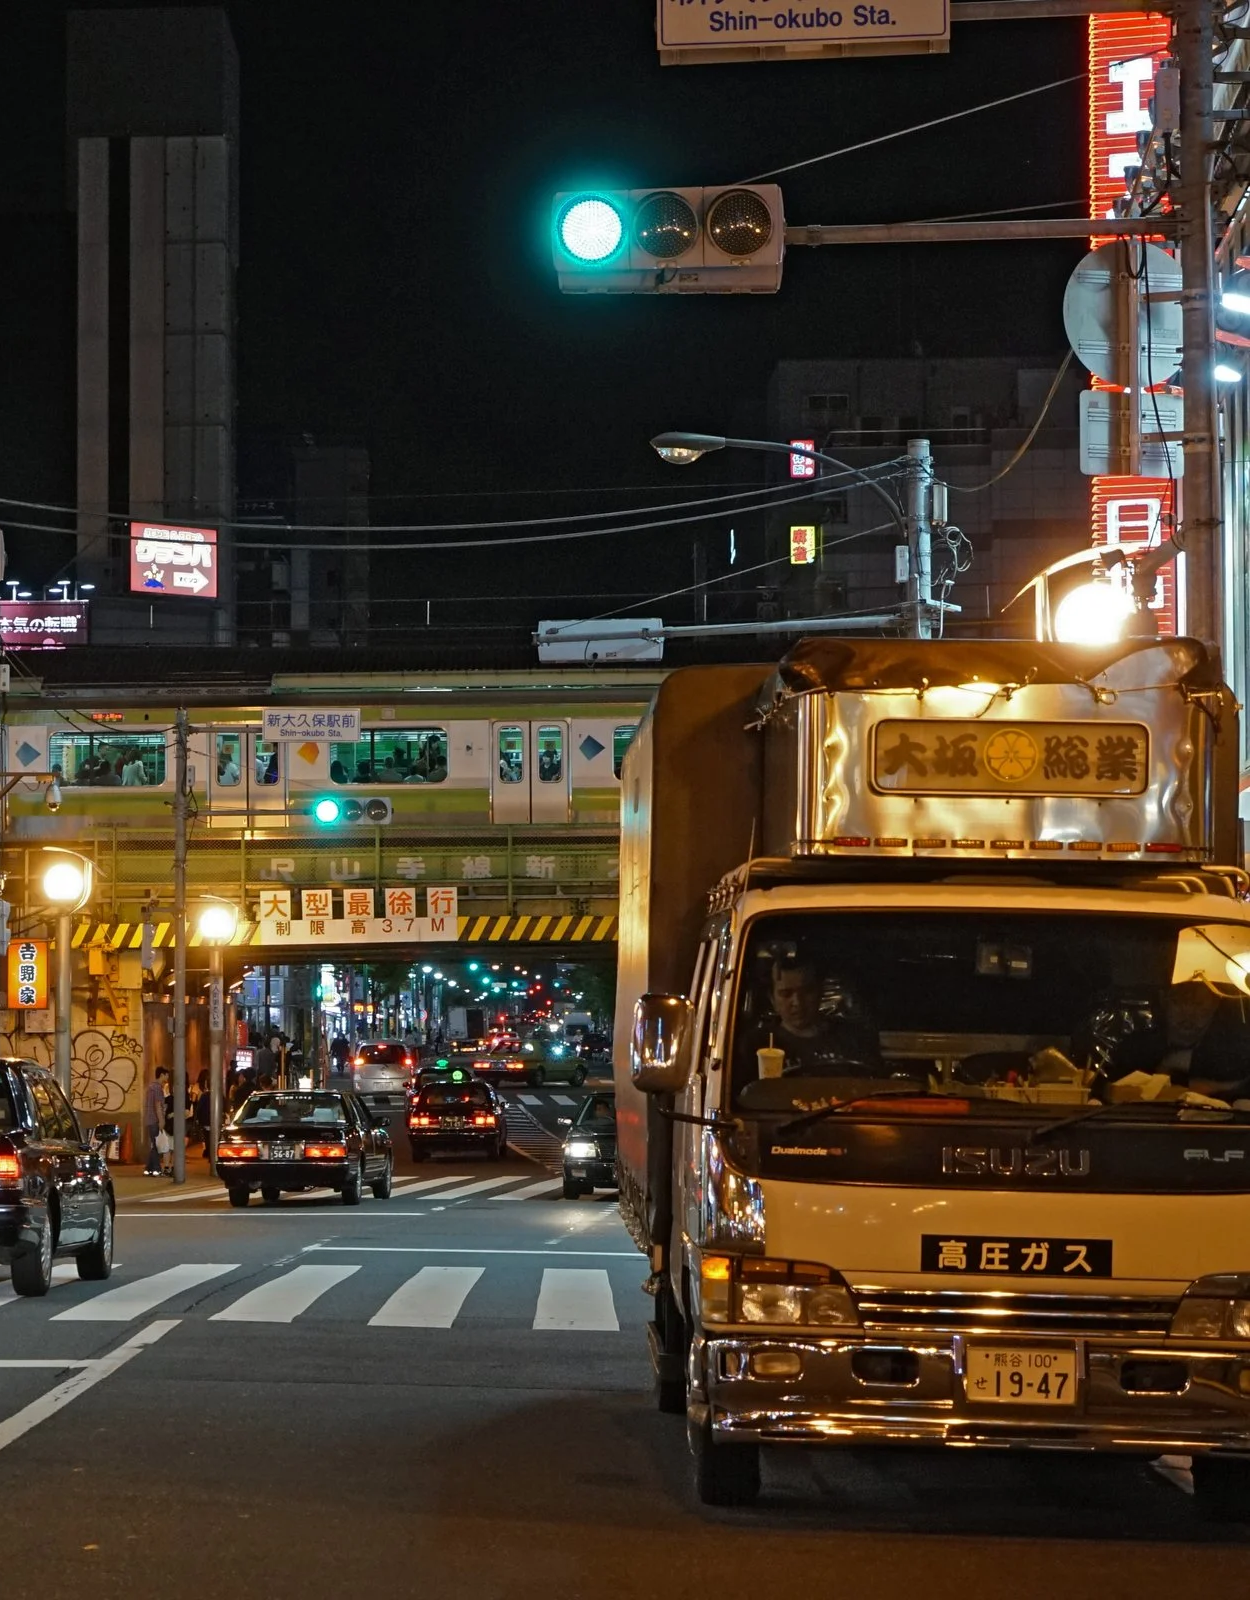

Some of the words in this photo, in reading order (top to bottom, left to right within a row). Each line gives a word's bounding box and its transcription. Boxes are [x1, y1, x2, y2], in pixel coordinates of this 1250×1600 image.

[708, 7, 844, 33] Shin-okubo
[853, 4, 897, 27] Sta.
[267, 713, 356, 728] 新大久保駅前
[280, 729, 325, 737] Shin-okubo
[328, 729, 343, 738] Sta.
[263, 889, 456, 919] 大型最徐行
[19, 942, 37, 1005] 吉野家
[273, 1150, 295, 1158] 56-87
[771, 1145, 828, 1157] Dualmode
[941, 1145, 1091, 1177] ISUZU
[937, 1239, 1093, 1274] 高圧ガス
[993, 1353, 1023, 1368] 熊谷
[1028, 1354, 1053, 1368] 100
[974, 1376, 989, 1390] せ
[995, 1370, 1069, 1399] 19-47
